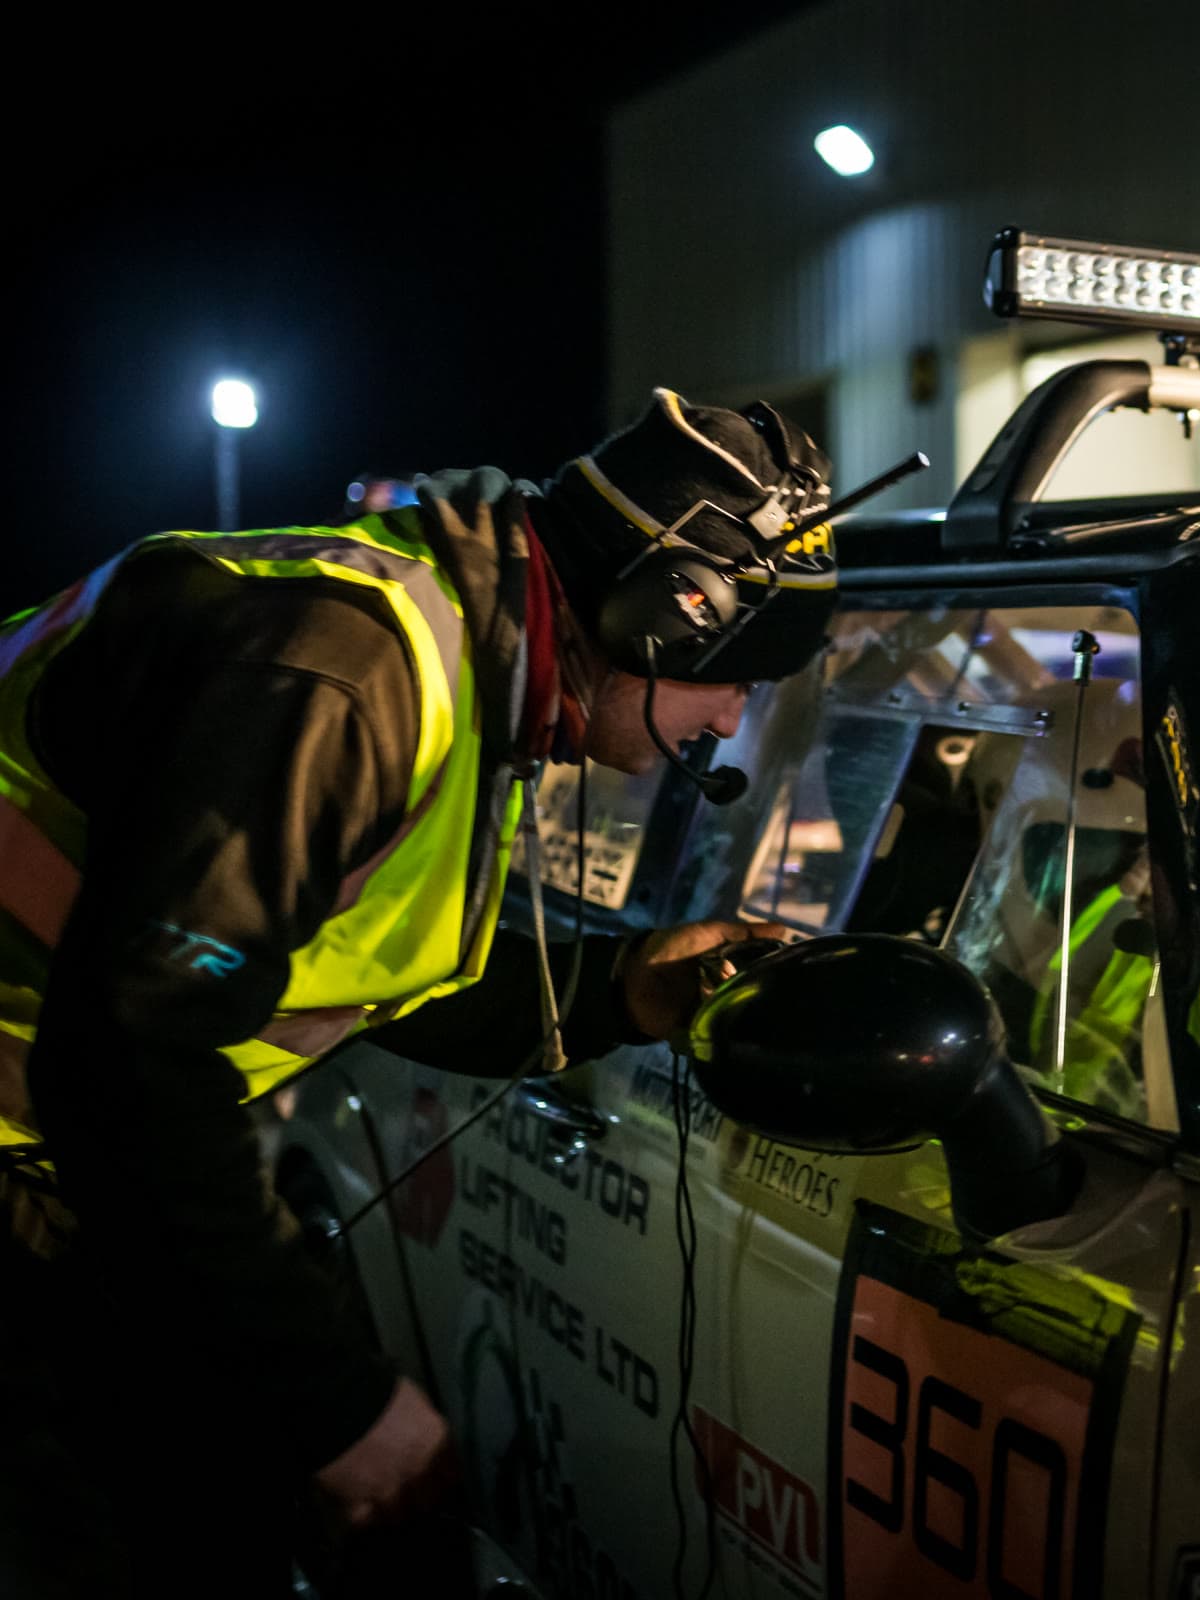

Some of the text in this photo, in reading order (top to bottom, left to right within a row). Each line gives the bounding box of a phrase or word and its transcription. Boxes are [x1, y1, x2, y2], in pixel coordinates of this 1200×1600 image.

[746, 1134, 840, 1217] HEROES
[597, 1327, 659, 1419] LTD
[846, 1334, 1068, 1600] 360
